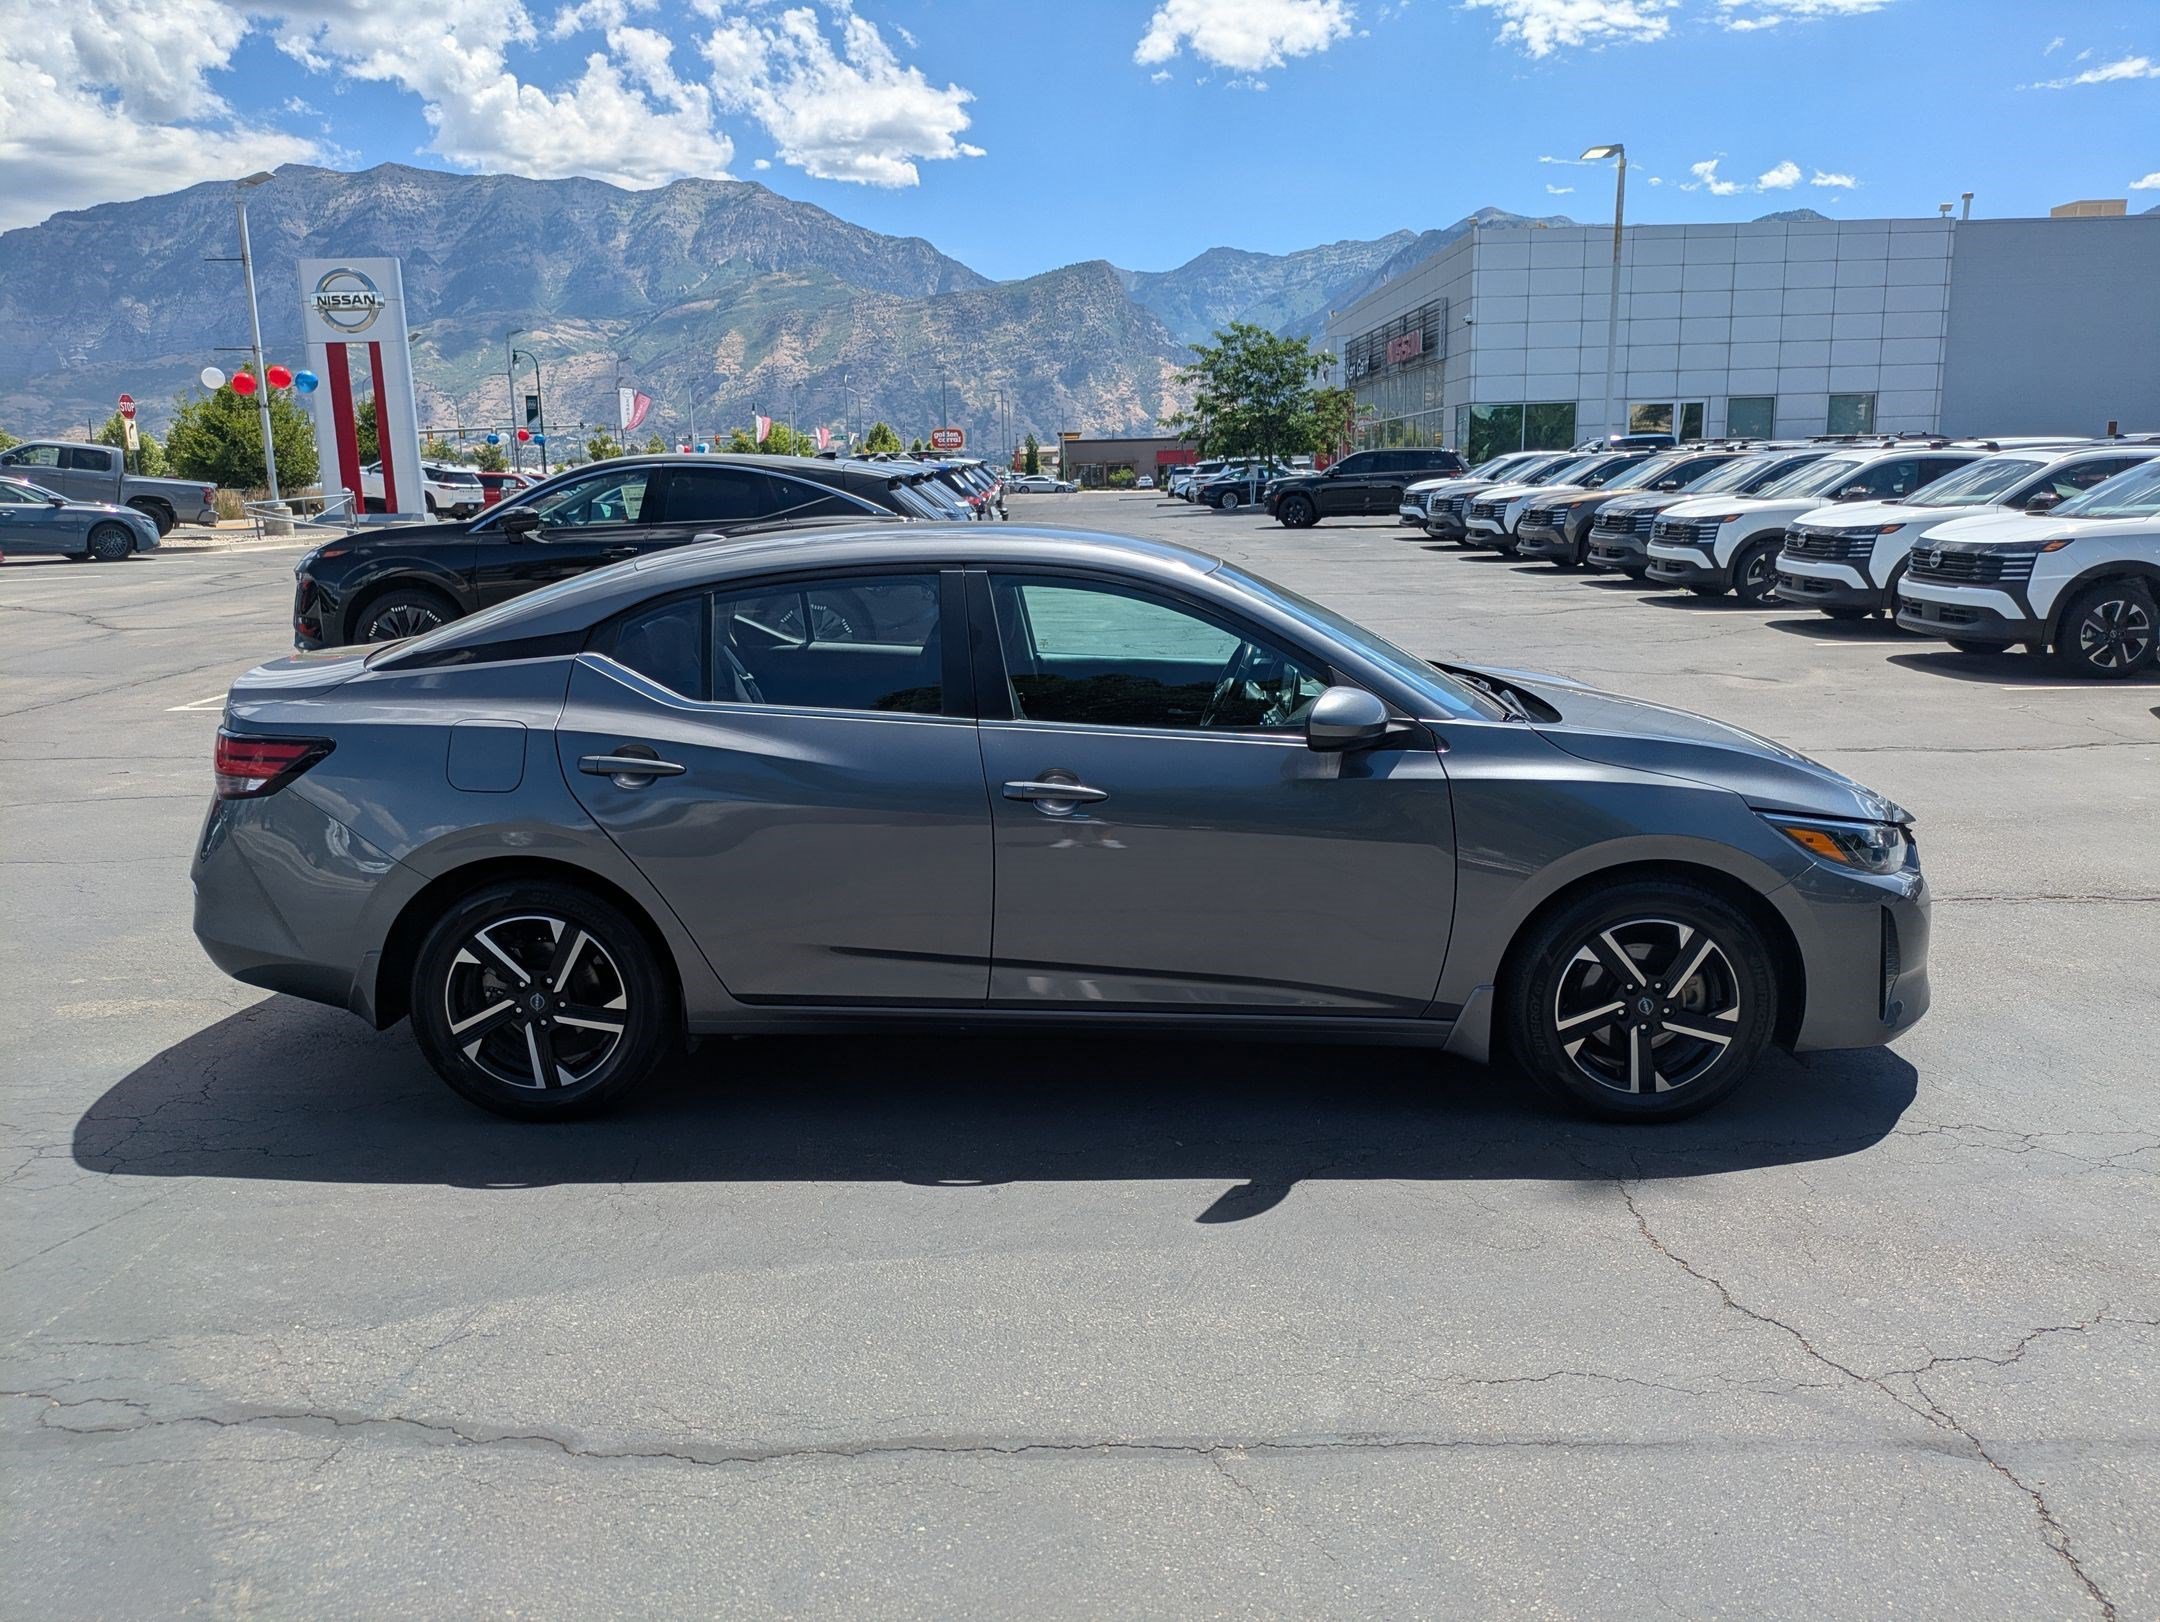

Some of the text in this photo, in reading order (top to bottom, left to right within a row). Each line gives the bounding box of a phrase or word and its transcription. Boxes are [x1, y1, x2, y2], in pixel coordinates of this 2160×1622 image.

[316, 294, 376, 306] NISSAN
[120, 401, 135, 412] STOP
[933, 431, 959, 439] golden
